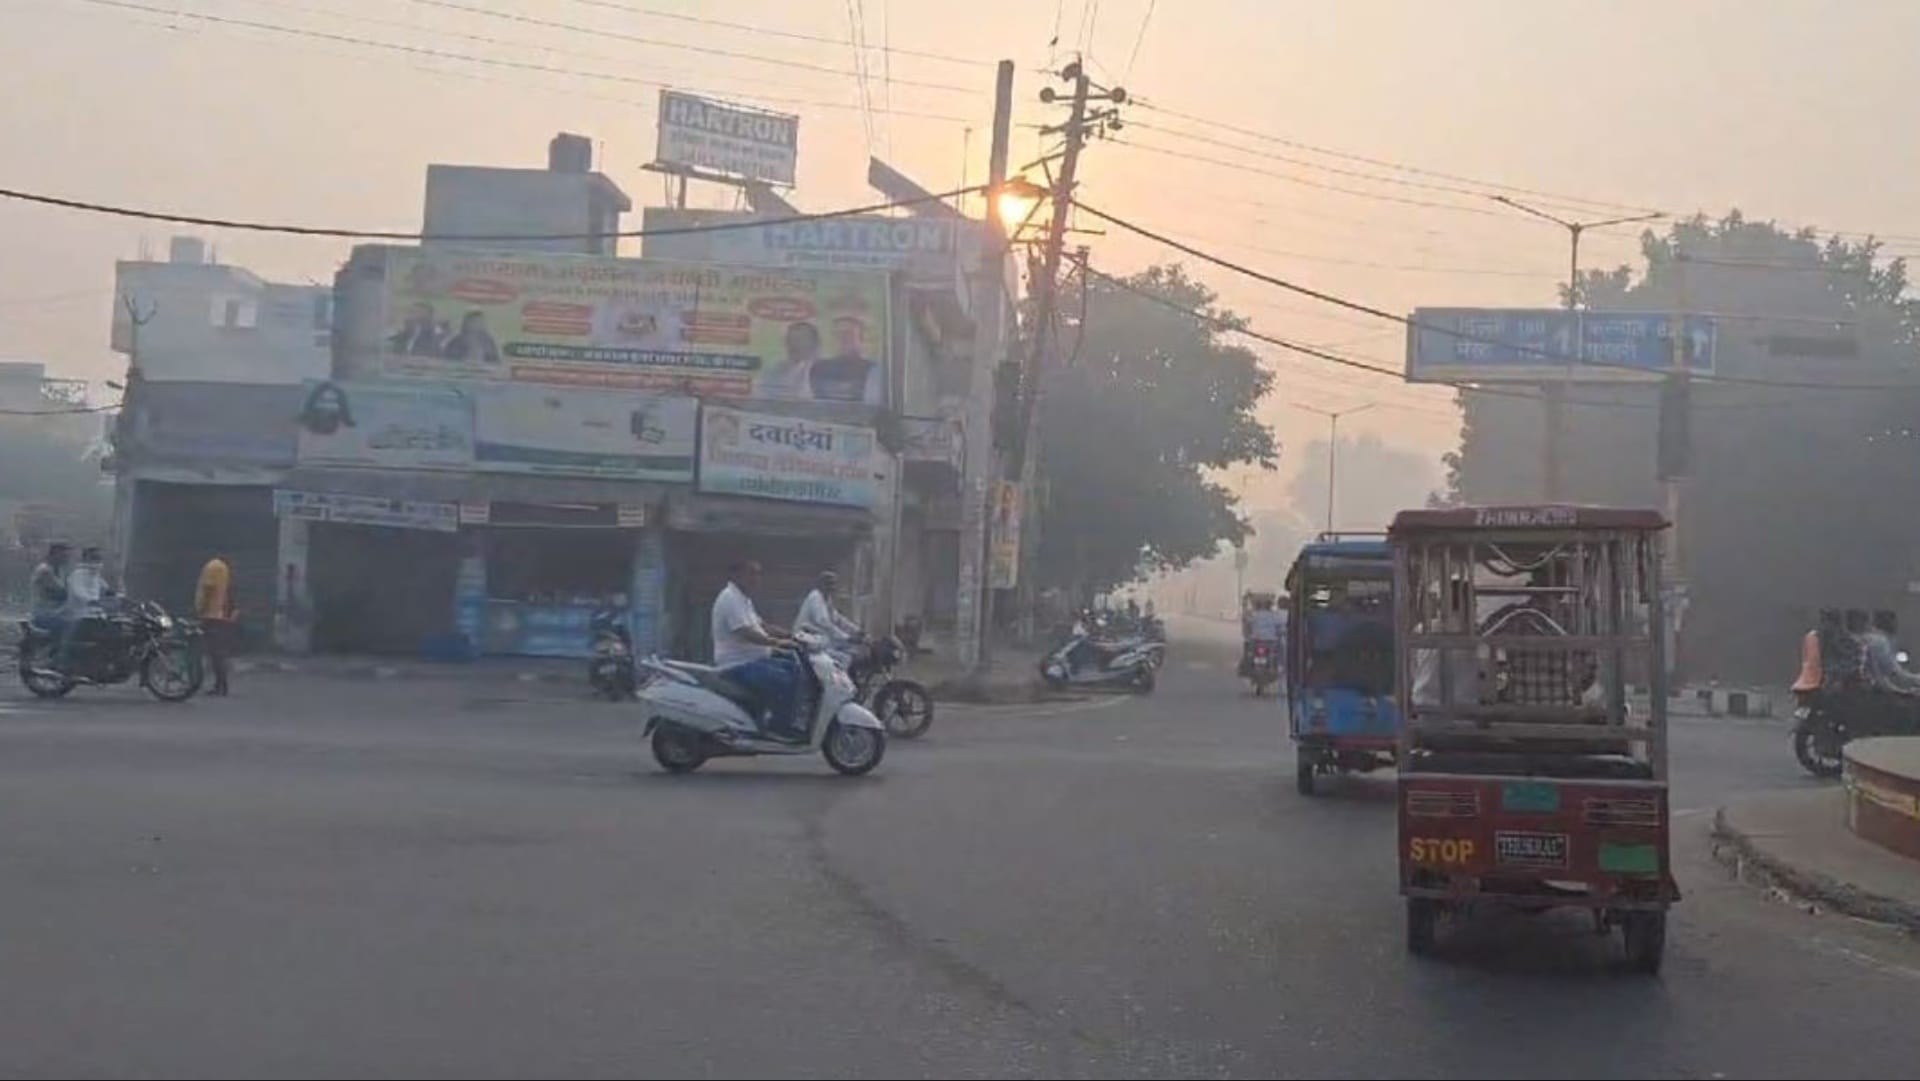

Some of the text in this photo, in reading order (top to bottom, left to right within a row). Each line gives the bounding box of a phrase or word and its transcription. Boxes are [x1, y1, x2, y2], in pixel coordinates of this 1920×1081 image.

[668, 98, 790, 144] HARTRON
[768, 219, 943, 250] HARTRON
[749, 422, 833, 451] दवाईयां
[1410, 837, 1475, 865] STOP
